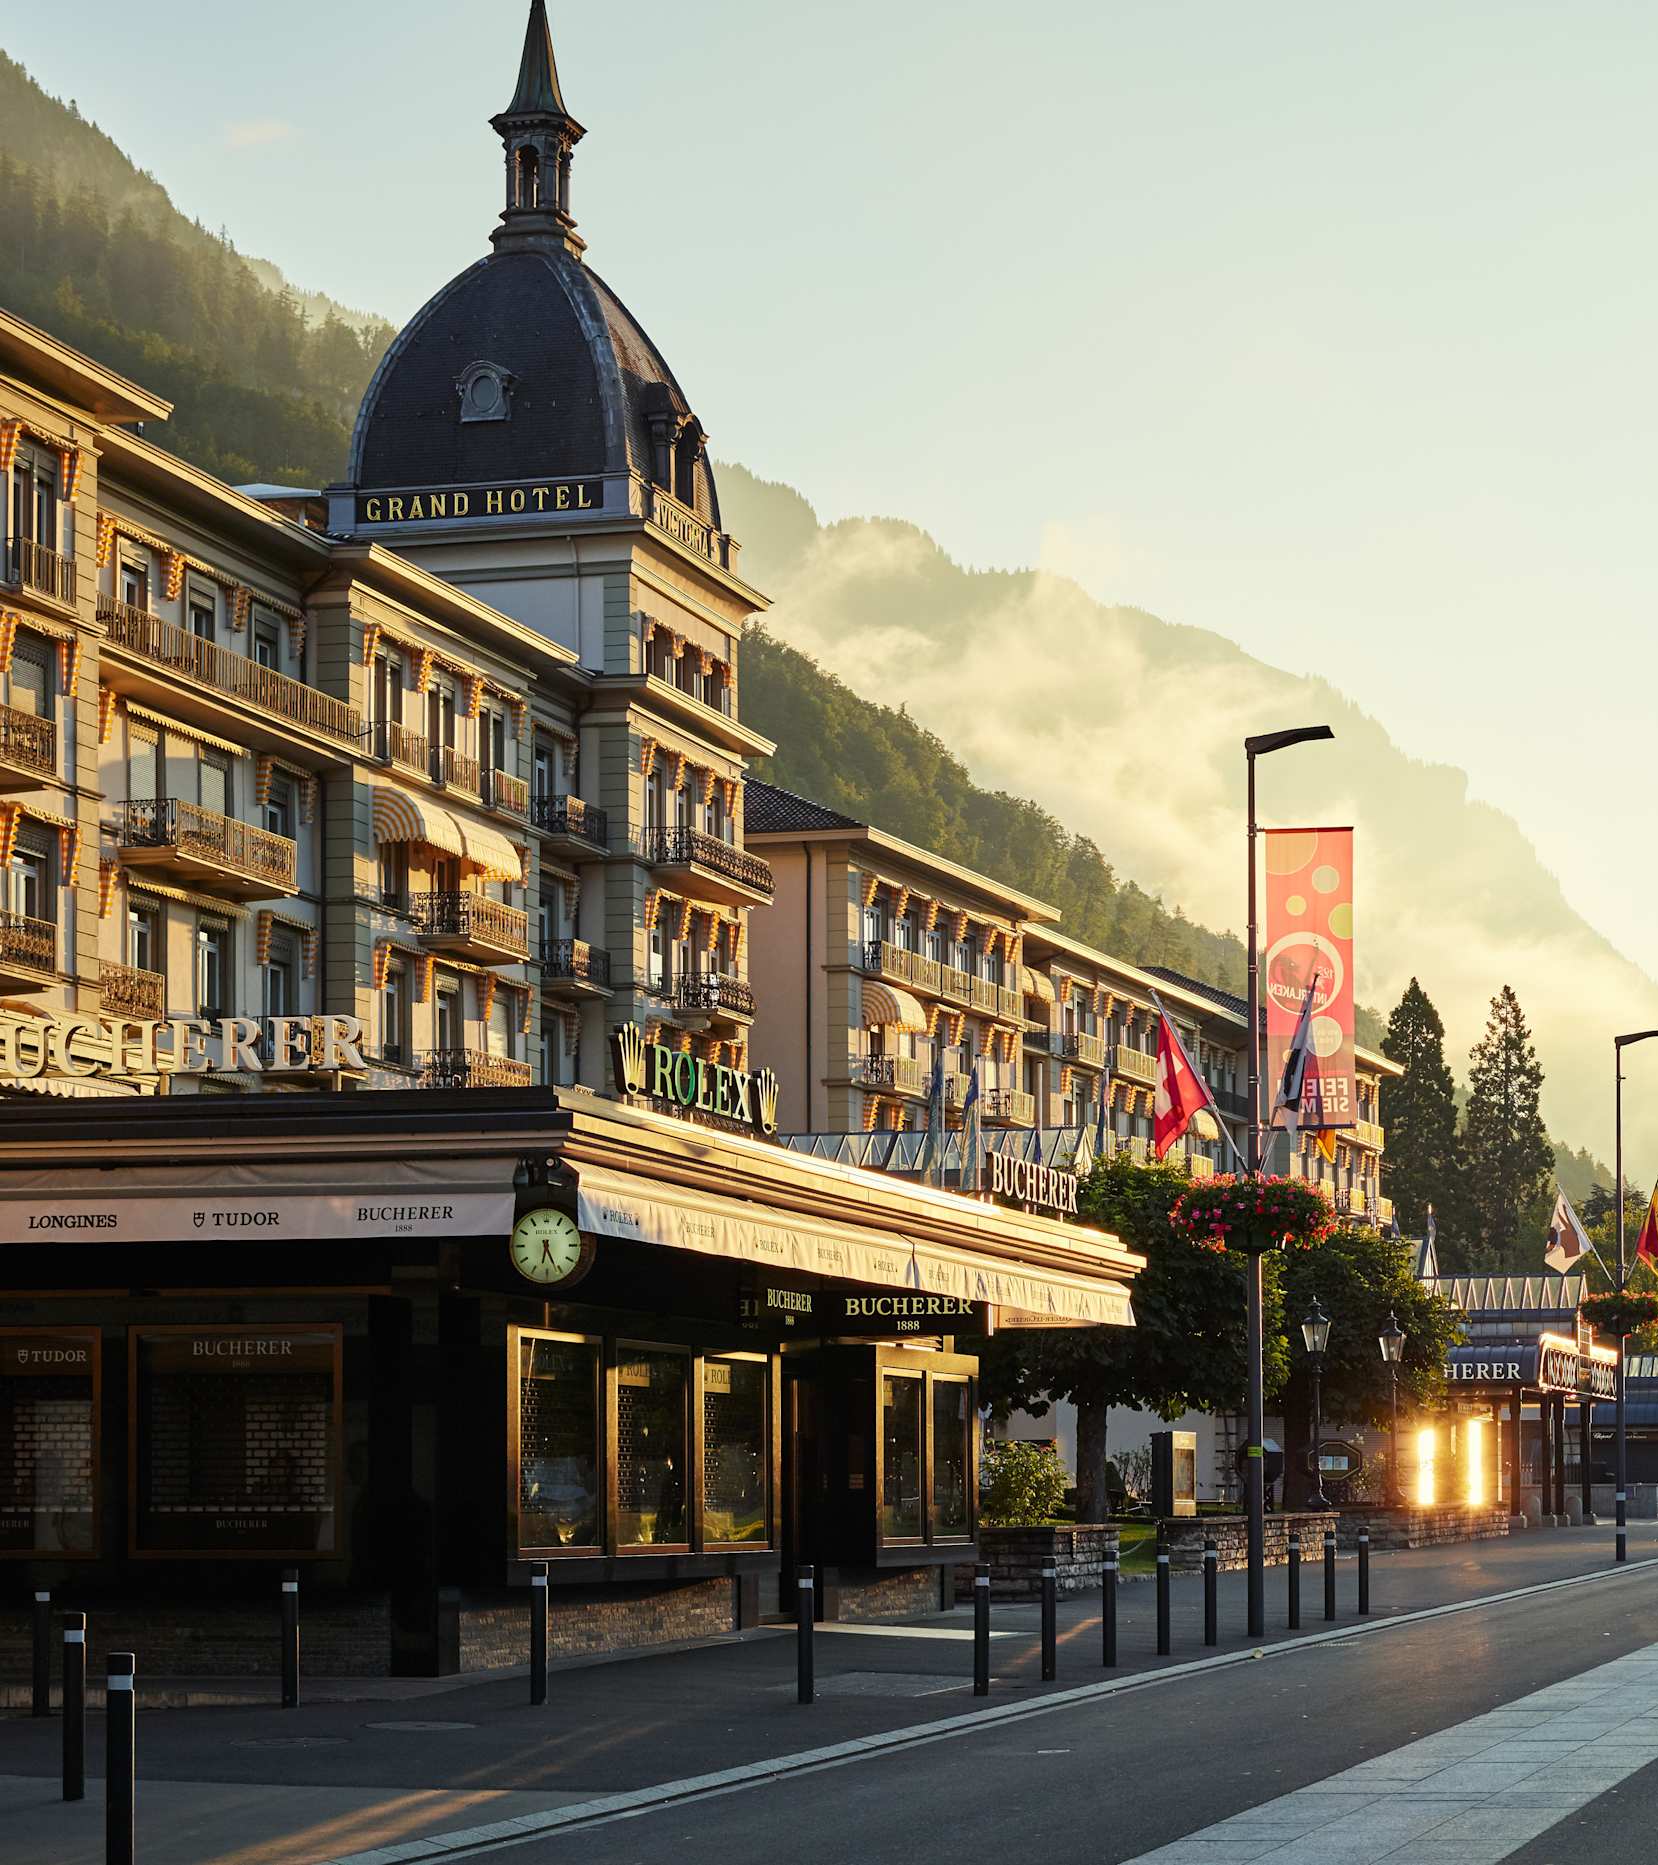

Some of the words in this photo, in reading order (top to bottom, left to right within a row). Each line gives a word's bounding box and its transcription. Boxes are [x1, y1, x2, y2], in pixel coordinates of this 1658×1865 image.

[366, 491, 469, 522] GRAND
[486, 484, 592, 514] HOTEL
[660, 501, 709, 558] VICTORIA
[0, 1014, 367, 1078] UCHERER
[652, 1043, 753, 1124] ROLEX
[992, 1151, 1079, 1215] BUCHERER
[28, 1214, 118, 1230] LONGINES
[212, 1211, 280, 1227] TUDOR
[357, 1206, 454, 1221] BUCHERER
[609, 1208, 635, 1227] ROLEX
[685, 1221, 716, 1239] BUCHERER
[759, 1239, 780, 1255] ROLEX
[766, 1288, 813, 1313] BUCHERER
[845, 1296, 974, 1316] BUCHERER
[897, 1320, 920, 1331] 1888
[31, 1350, 88, 1364] TUDOR
[193, 1340, 293, 1356] BUCHERER
[1444, 1361, 1522, 1381] HERER
